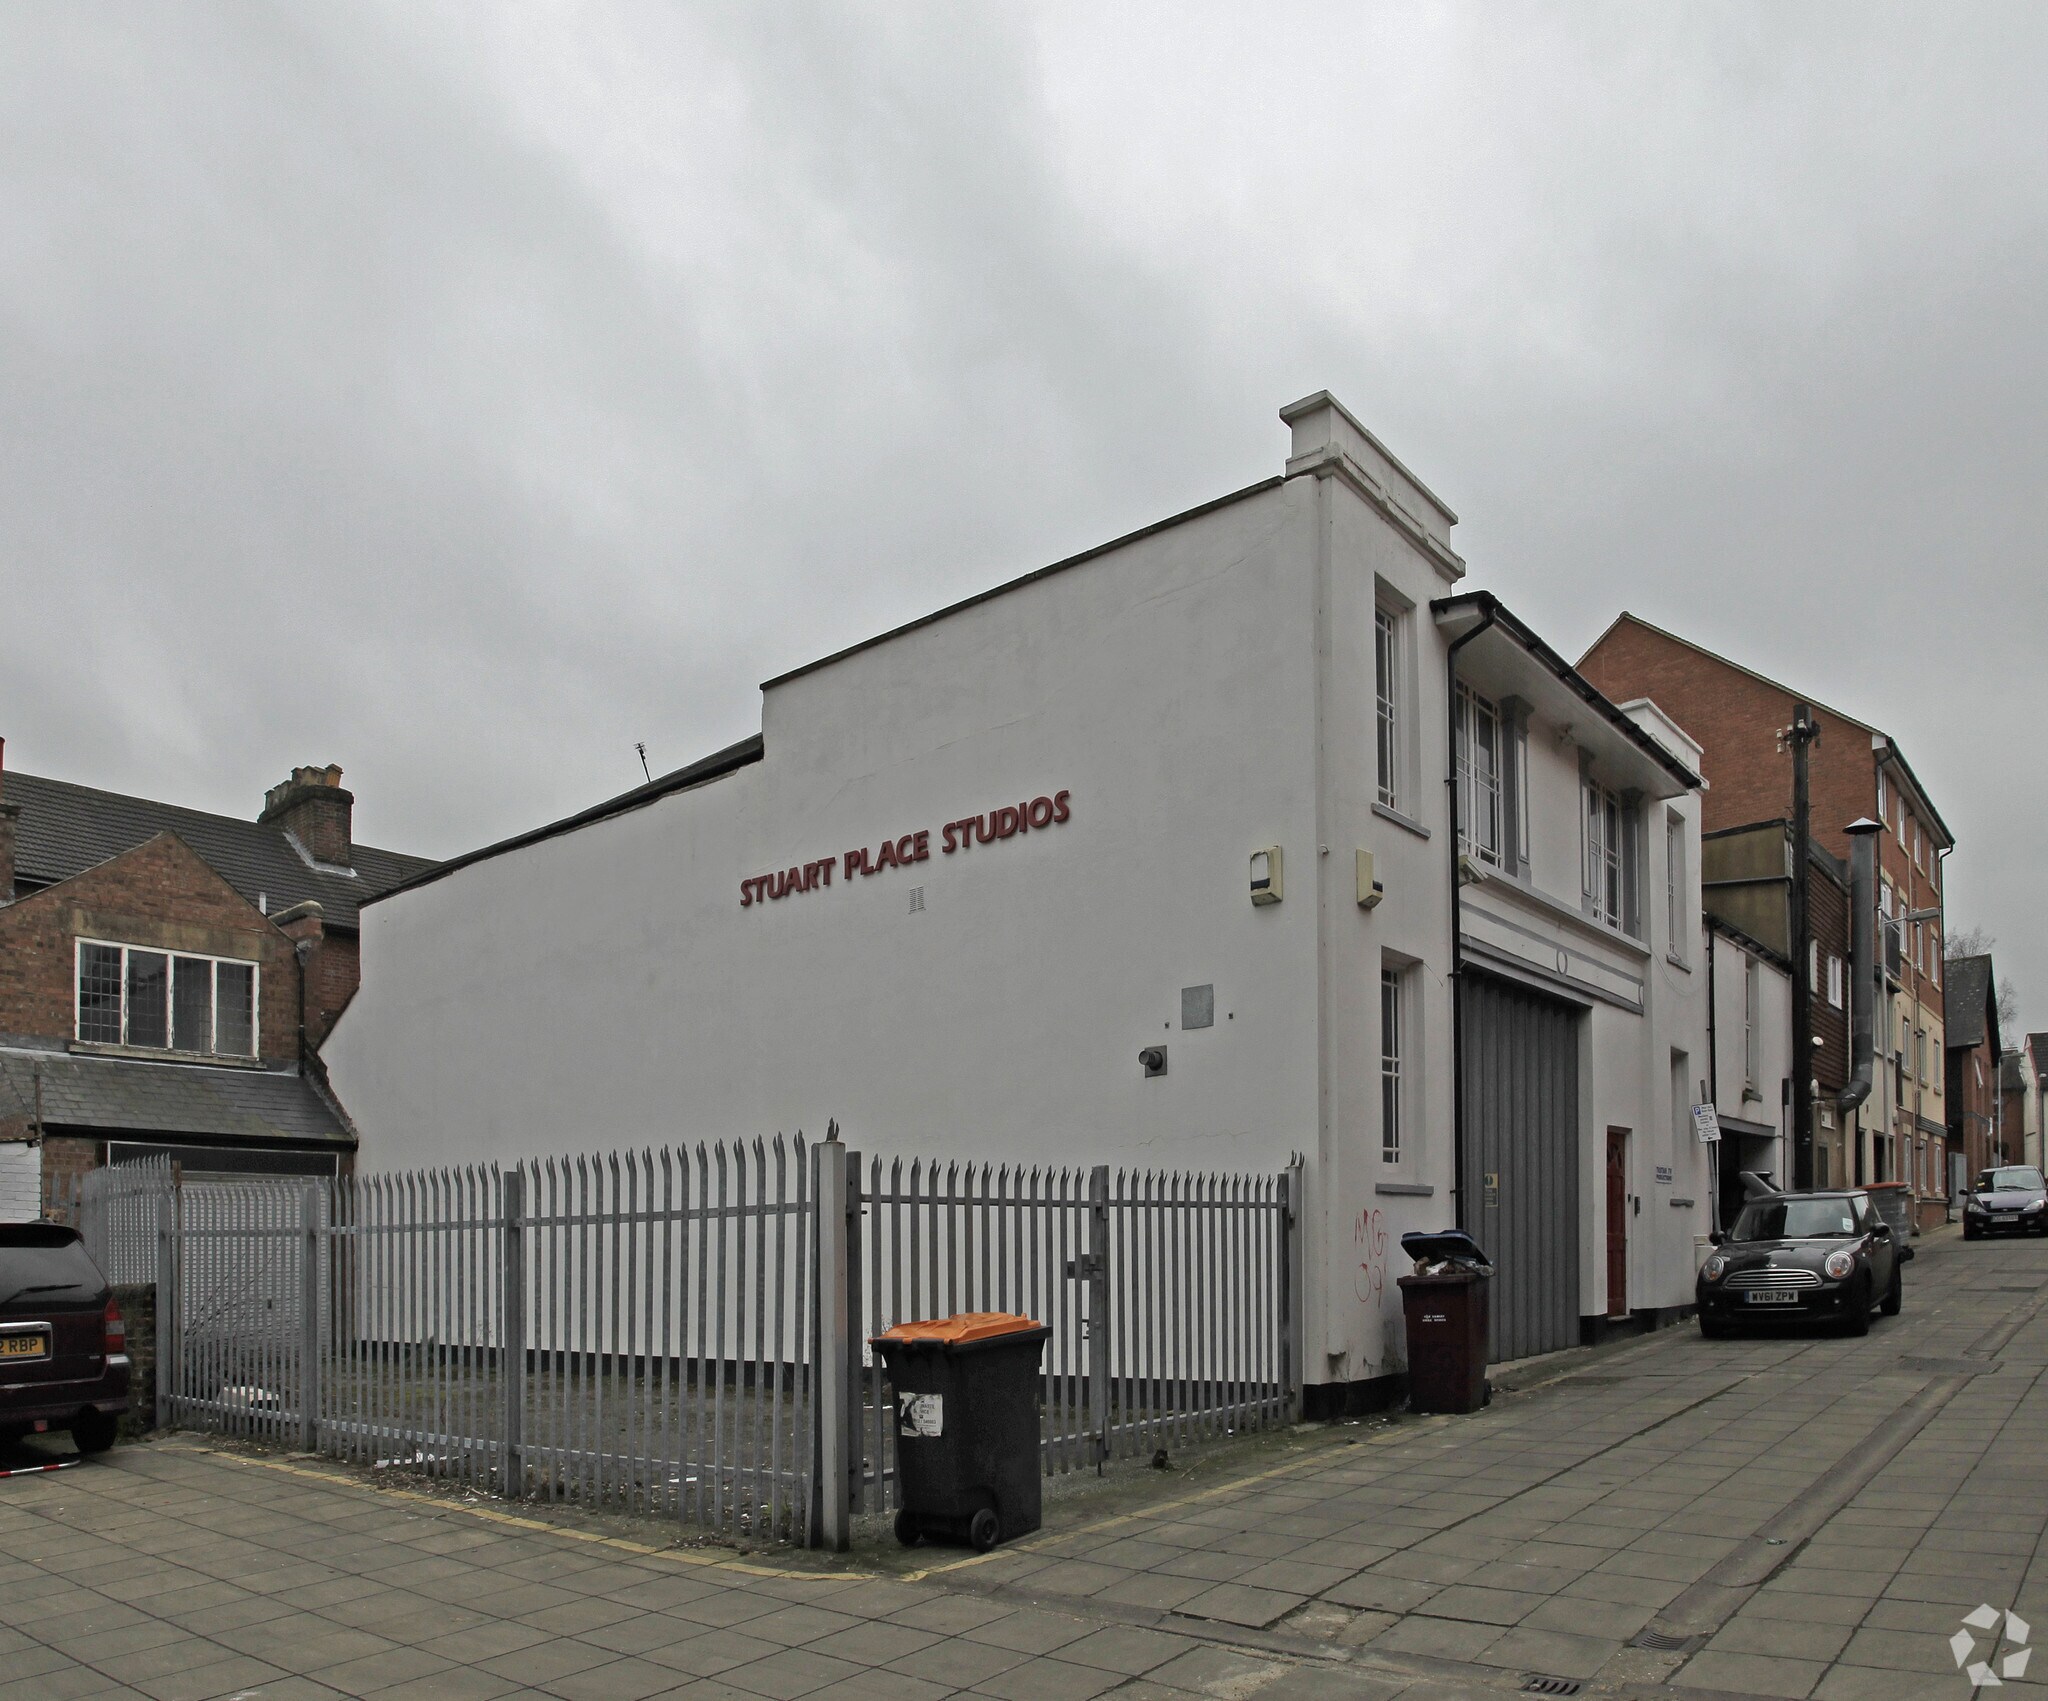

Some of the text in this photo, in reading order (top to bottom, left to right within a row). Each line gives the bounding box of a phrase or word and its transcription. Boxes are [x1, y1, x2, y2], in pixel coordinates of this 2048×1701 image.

[739, 789, 1071, 907] STUART PLACE STUDIOS
[1776, 1291, 1795, 1301] ZPW
[9, 1338, 38, 1353] RBP
